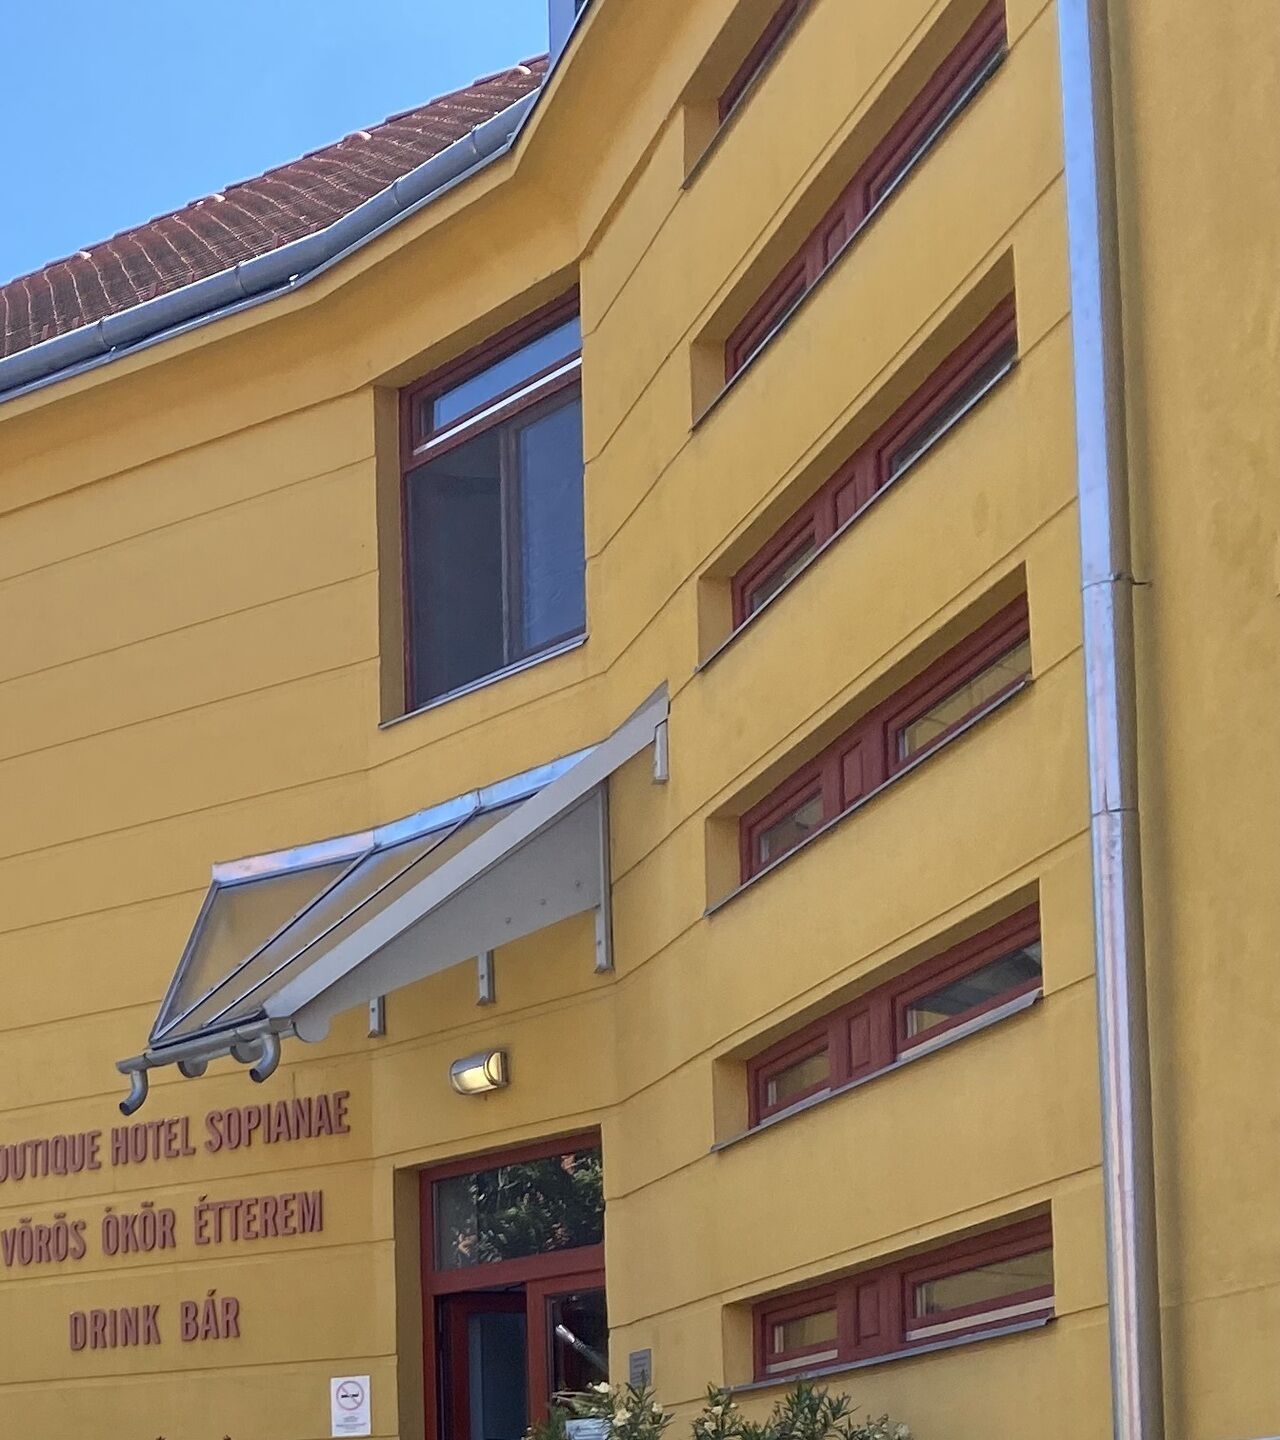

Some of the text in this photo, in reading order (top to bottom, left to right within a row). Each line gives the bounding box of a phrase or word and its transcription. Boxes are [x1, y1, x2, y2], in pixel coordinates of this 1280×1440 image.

[110, 1115, 196, 1165] HOTEL
[204, 1090, 351, 1153] SOPIANAE
[193, 1190, 323, 1246] ÉTTEREM
[69, 1289, 241, 1352] DRINK BÁR
